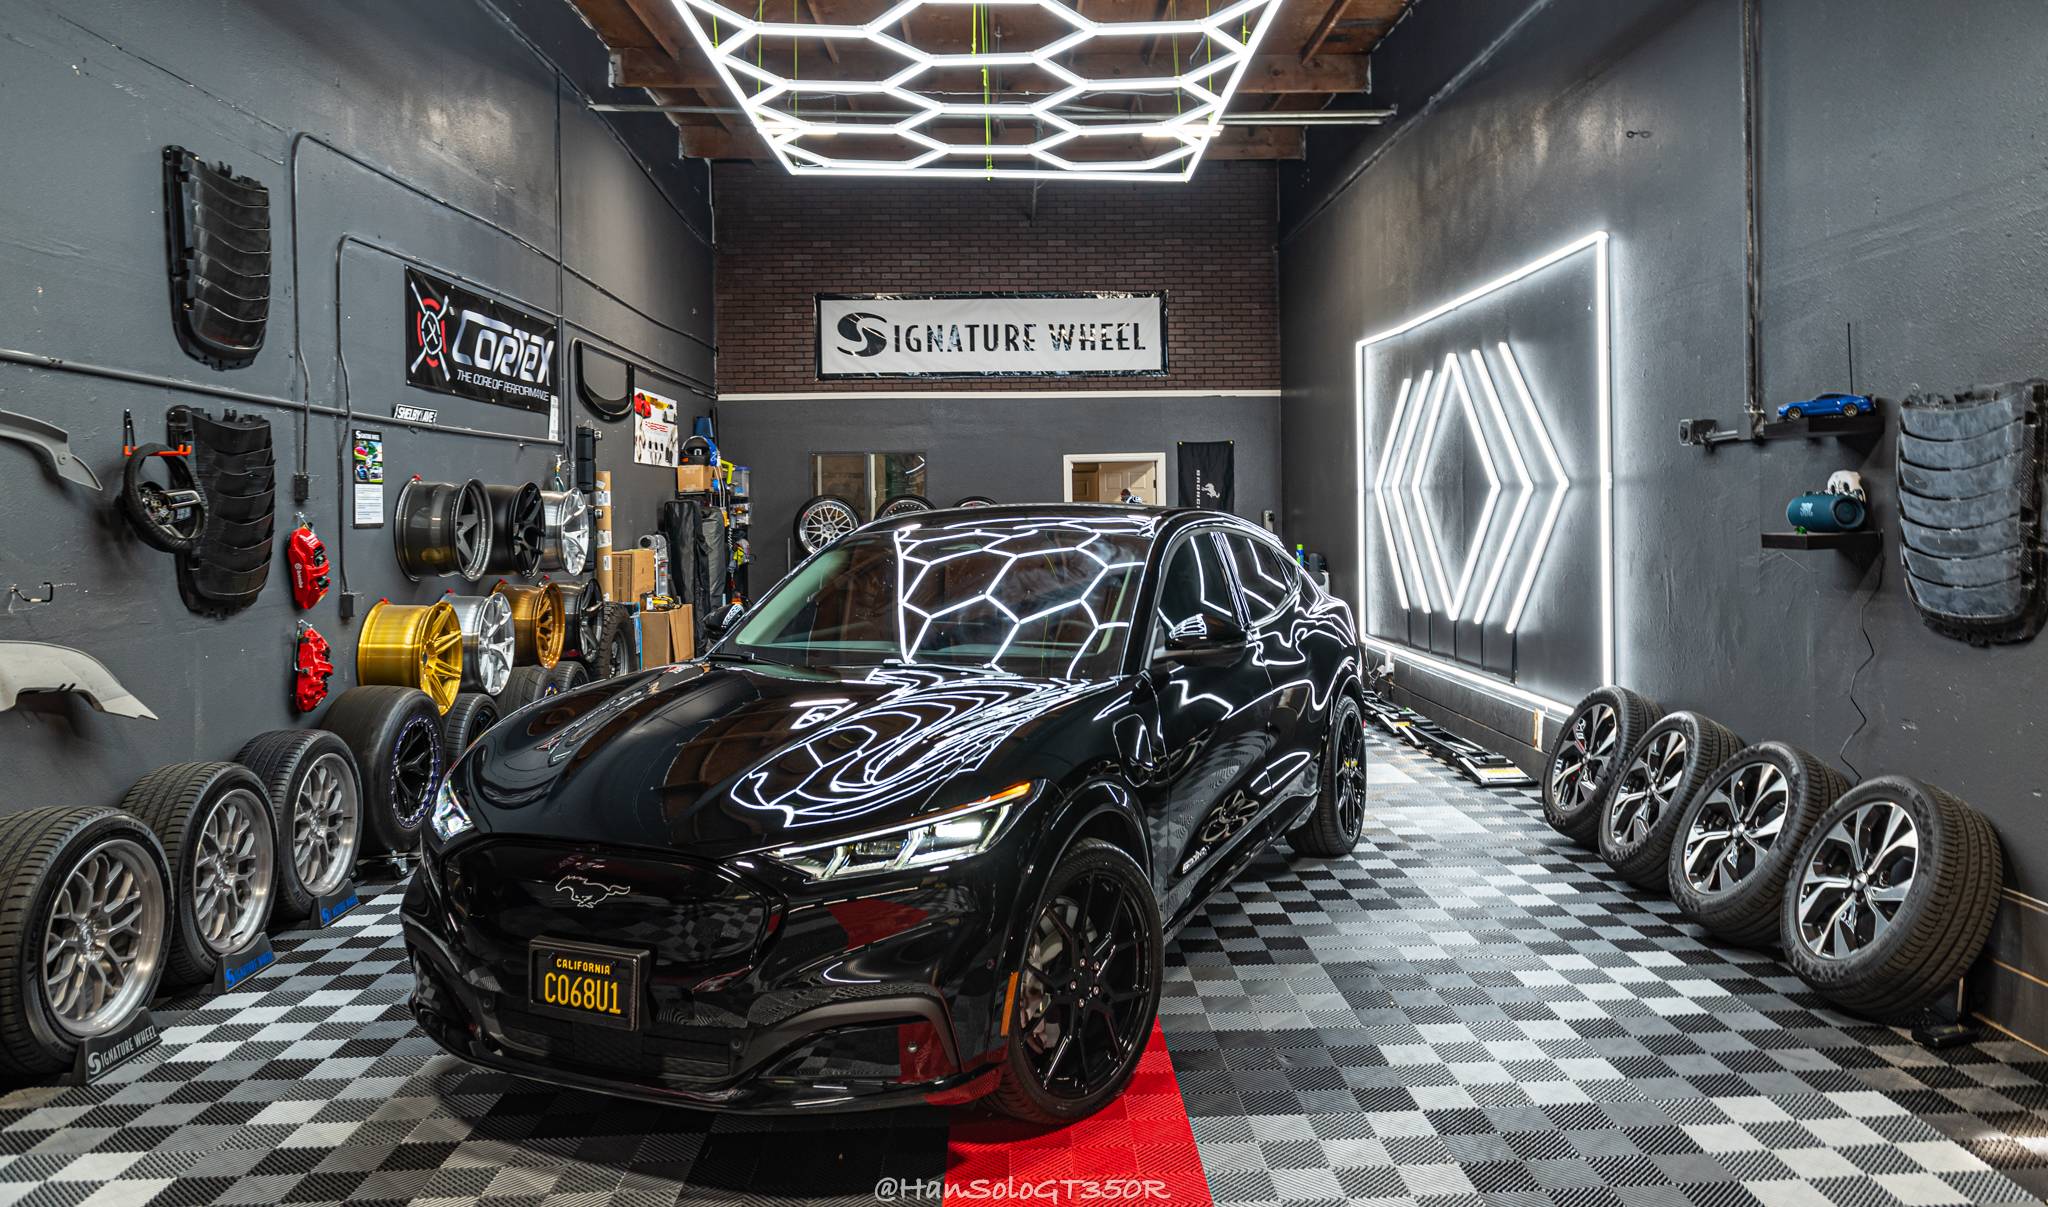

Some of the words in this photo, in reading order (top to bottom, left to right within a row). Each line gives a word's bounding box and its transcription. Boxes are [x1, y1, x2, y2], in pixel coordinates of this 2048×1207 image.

[837, 311, 1036, 357] SIGNATURE
[1048, 322, 1146, 352] WHEEL
[457, 369, 473, 384] THE
[473, 373, 493, 388] CORE
[492, 379, 503, 390] OF
[503, 381, 550, 402] PERFORMANCE
[556, 958, 610, 975] CALIFORNIA
[87, 1036, 134, 1075] SIGNATURE
[133, 1024, 157, 1048] WHEEL
